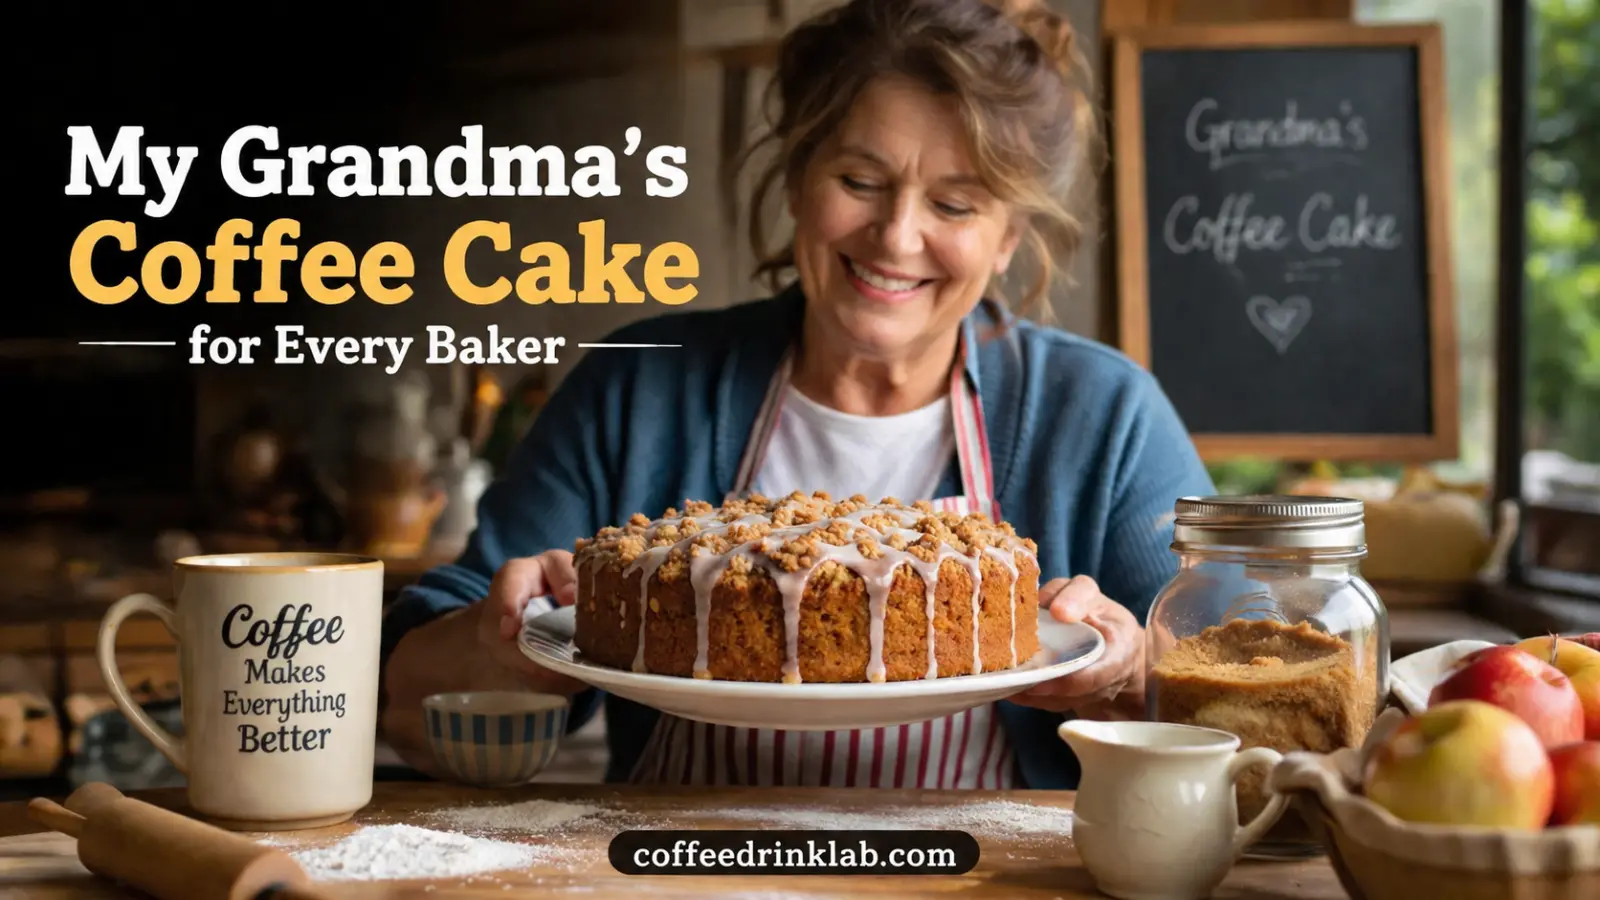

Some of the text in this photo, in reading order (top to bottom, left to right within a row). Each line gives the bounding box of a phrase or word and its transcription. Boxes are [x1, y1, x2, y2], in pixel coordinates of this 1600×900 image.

[1163, 192, 1400, 264] Coffee Cake
[221, 603, 345, 660] Coffee
[244, 658, 326, 685] Makes
[222, 689, 346, 723] Everything
[237, 724, 332, 753] Better
